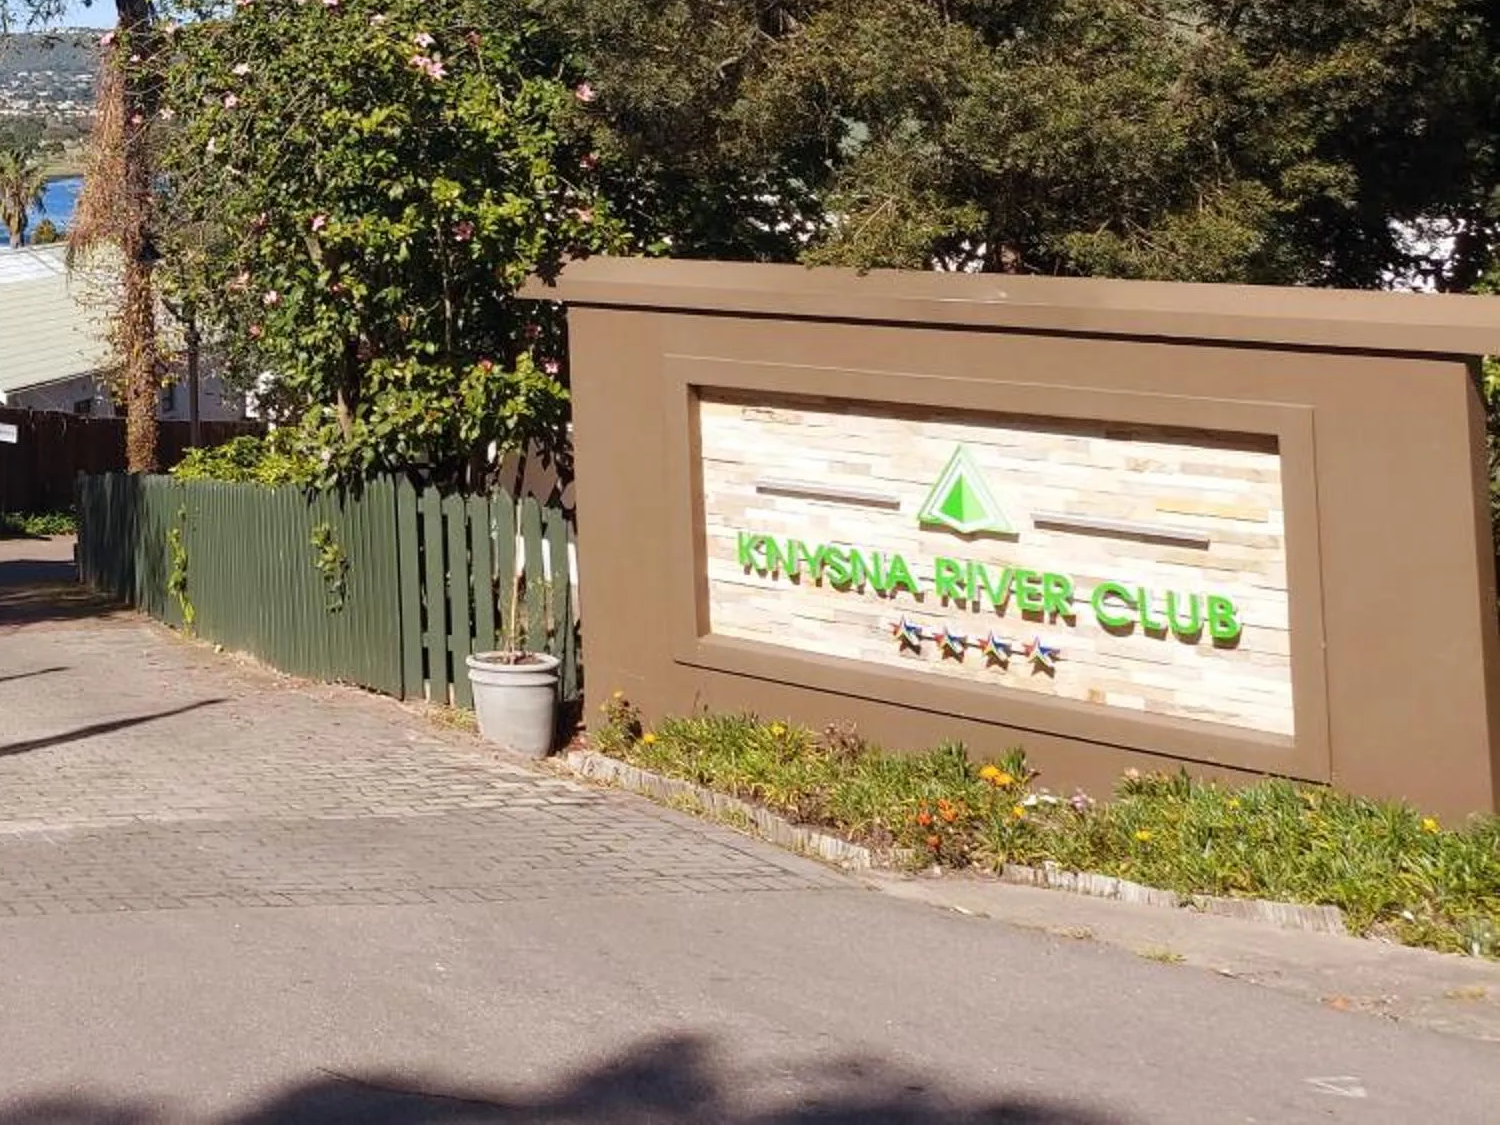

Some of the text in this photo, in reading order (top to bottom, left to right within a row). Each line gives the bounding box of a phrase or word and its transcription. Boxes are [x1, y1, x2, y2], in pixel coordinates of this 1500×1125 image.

[736, 530, 1242, 641] KNYSNA RIVER CLUB
